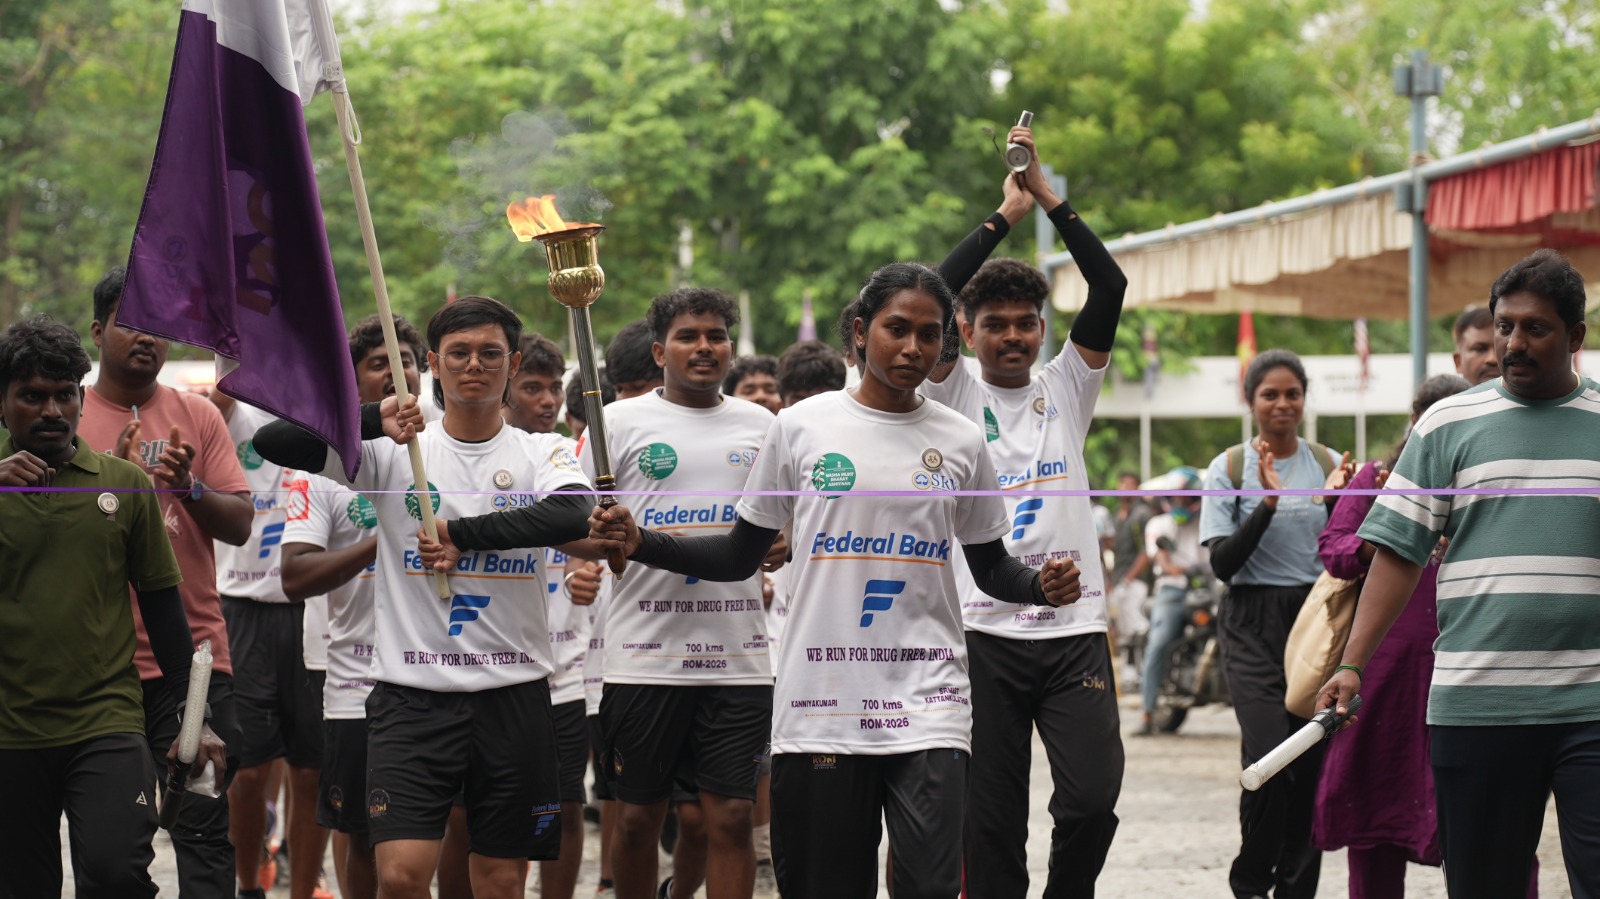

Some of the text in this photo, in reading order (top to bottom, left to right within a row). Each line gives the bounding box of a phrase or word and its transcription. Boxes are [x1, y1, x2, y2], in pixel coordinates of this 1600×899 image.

[643, 504, 718, 526] Federal
[811, 530, 950, 560] Federal Bank
[483, 552, 538, 574] Bank
[638, 600, 651, 612] WE
[654, 600, 672, 612] RUN
[674, 600, 694, 612] FOR
[696, 600, 722, 612] DRUG
[725, 600, 744, 612] FREE
[1014, 611, 1056, 622] ROM-2026
[685, 644, 724, 652] 700 kms
[404, 651, 416, 664] WE
[418, 651, 438, 664] RUN
[441, 654, 462, 666] FOR
[463, 652, 490, 666] DRUG
[491, 652, 517, 665] FREE
[806, 648, 954, 662] WE RUN FOR DRUG FREE INDIA
[682, 660, 727, 669] ROM-2026
[791, 700, 838, 708] KANNIYAKUMARI
[862, 699, 903, 710] 700 kms
[860, 717, 910, 730] ROM-2026
